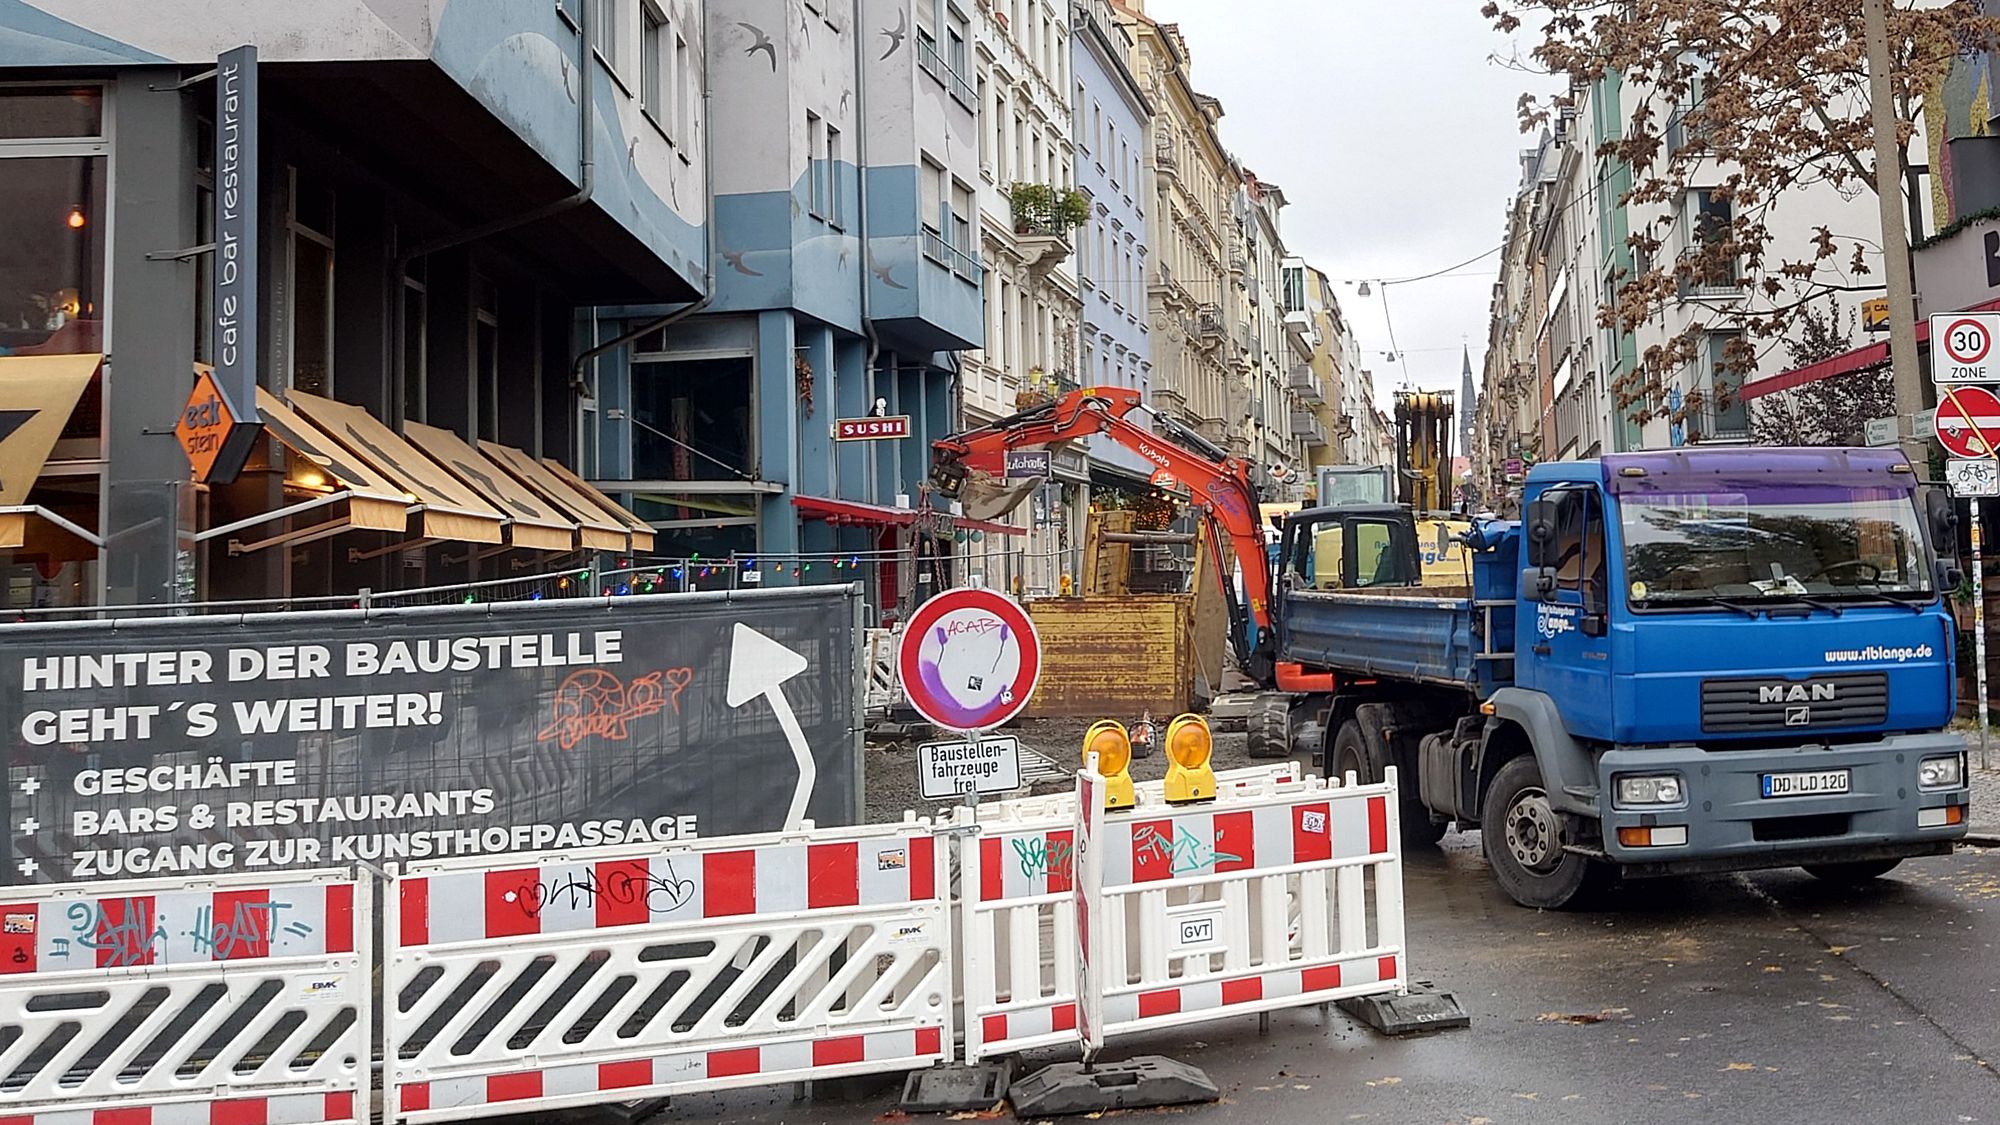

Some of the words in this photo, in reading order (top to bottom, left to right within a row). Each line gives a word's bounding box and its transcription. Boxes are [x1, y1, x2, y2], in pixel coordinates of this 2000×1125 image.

[222, 62, 239, 220] restaurant
[220, 233, 238, 285] bar
[219, 295, 236, 366] cafe
[1954, 331, 1981, 352] 30
[1951, 367, 1987, 379] ZONE
[185, 394, 221, 430] eck
[844, 422, 902, 435] SUSHI
[187, 428, 219, 454] stein
[1139, 442, 1170, 467] Kubota
[948, 618, 1000, 637] ACAB
[23, 650, 213, 691] HINTER
[228, 645, 331, 682] DER
[345, 630, 624, 677] BAUSTELLE
[1825, 643, 1933, 662] www.rlblange.de
[1759, 683, 1835, 703] MAN
[231, 691, 443, 735] WEITER!
[931, 743, 1008, 762] Baustellen-
[74, 757, 297, 796] GESCHÄFTE
[932, 761, 998, 778] fahrzeuge
[954, 776, 976, 792] frei
[1821, 774, 1846, 790] 120
[73, 805, 178, 836] BARS
[189, 804, 216, 829] &
[226, 788, 495, 828] RESTAURANTS
[72, 842, 234, 877] ZUGANG
[245, 838, 321, 866] ZUR
[332, 815, 698, 861] KUNSTHOFPASSAGE
[899, 926, 921, 935] BMK
[1184, 924, 1210, 938] GVT
[312, 981, 337, 989] BMK
